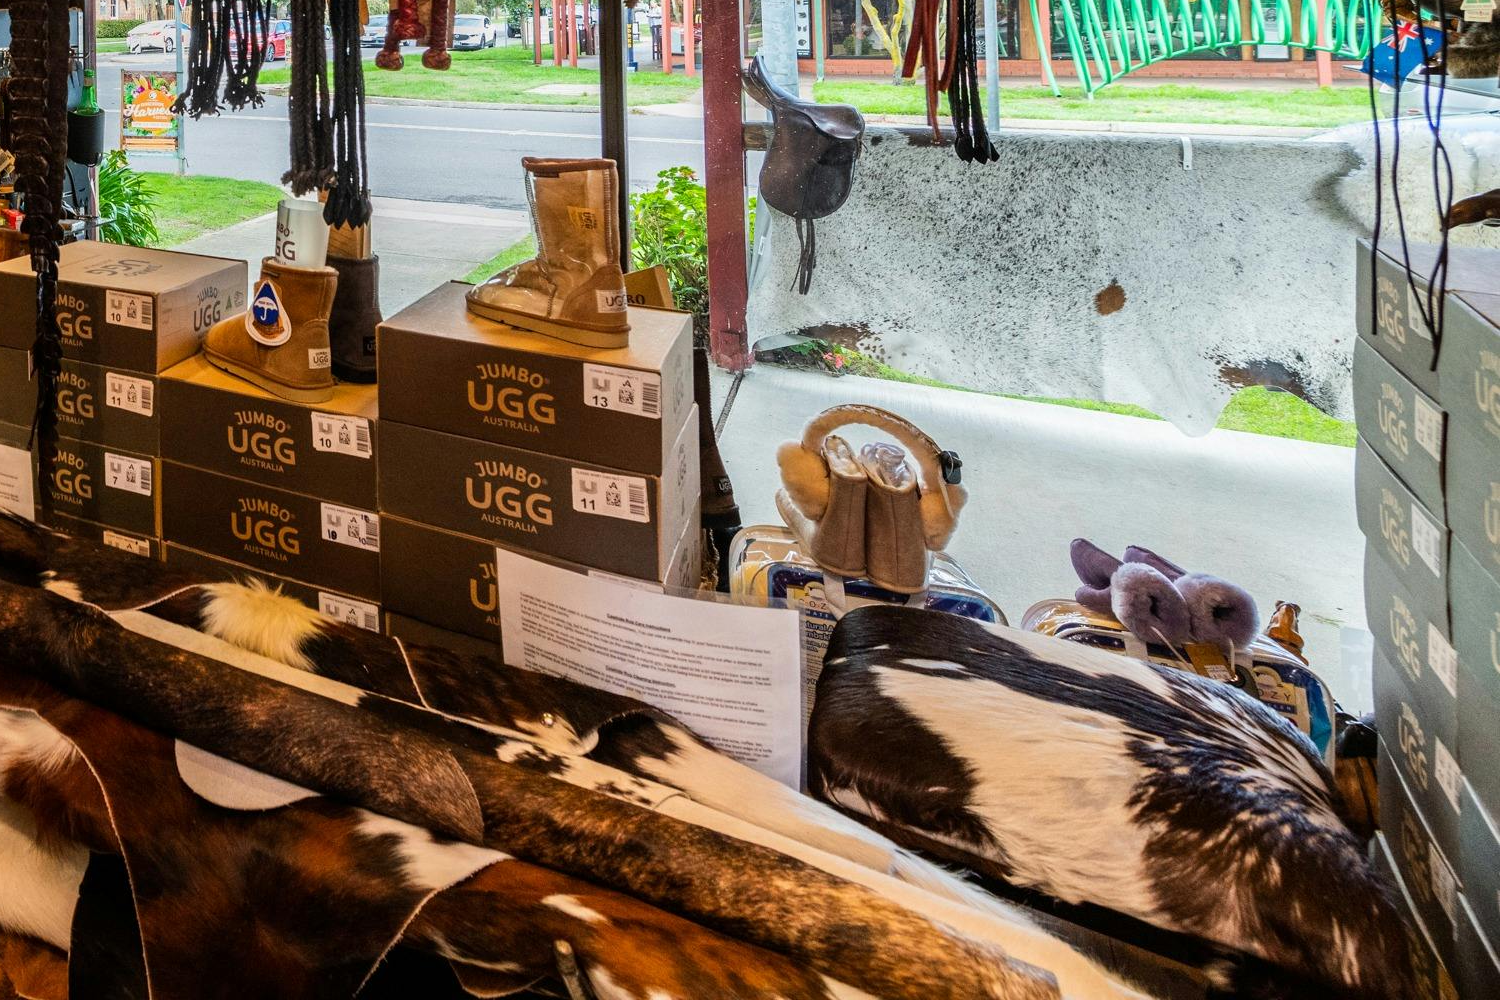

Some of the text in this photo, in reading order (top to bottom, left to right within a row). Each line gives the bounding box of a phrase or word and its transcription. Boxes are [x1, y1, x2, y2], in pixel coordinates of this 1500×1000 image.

[110, 312, 121, 323] 10
[193, 300, 221, 332] UGG
[1377, 299, 1406, 345] UGG
[313, 355, 329, 364] UGG
[476, 363, 544, 389] JUMBO
[111, 396, 121, 406] 11
[467, 380, 556, 425] UGG
[592, 395, 609, 408] 13
[234, 411, 287, 434] JUMBO
[482, 416, 541, 434] AUSTRALIA
[1378, 399, 1409, 456] UGG
[228, 426, 296, 465] UGG
[319, 437, 332, 449] 10
[240, 456, 285, 473] AUSTRALIA
[474, 460, 542, 489] JUMBO
[112, 476, 118, 485] 7
[238, 499, 290, 523] JUMBO
[465, 477, 554, 526] UGG
[580, 498, 596, 511] 11
[231, 512, 300, 555] UGG
[481, 513, 538, 535] AUSTRALIA
[1380, 503, 1410, 566] UGG
[244, 544, 288, 561] AUSTRALIA
